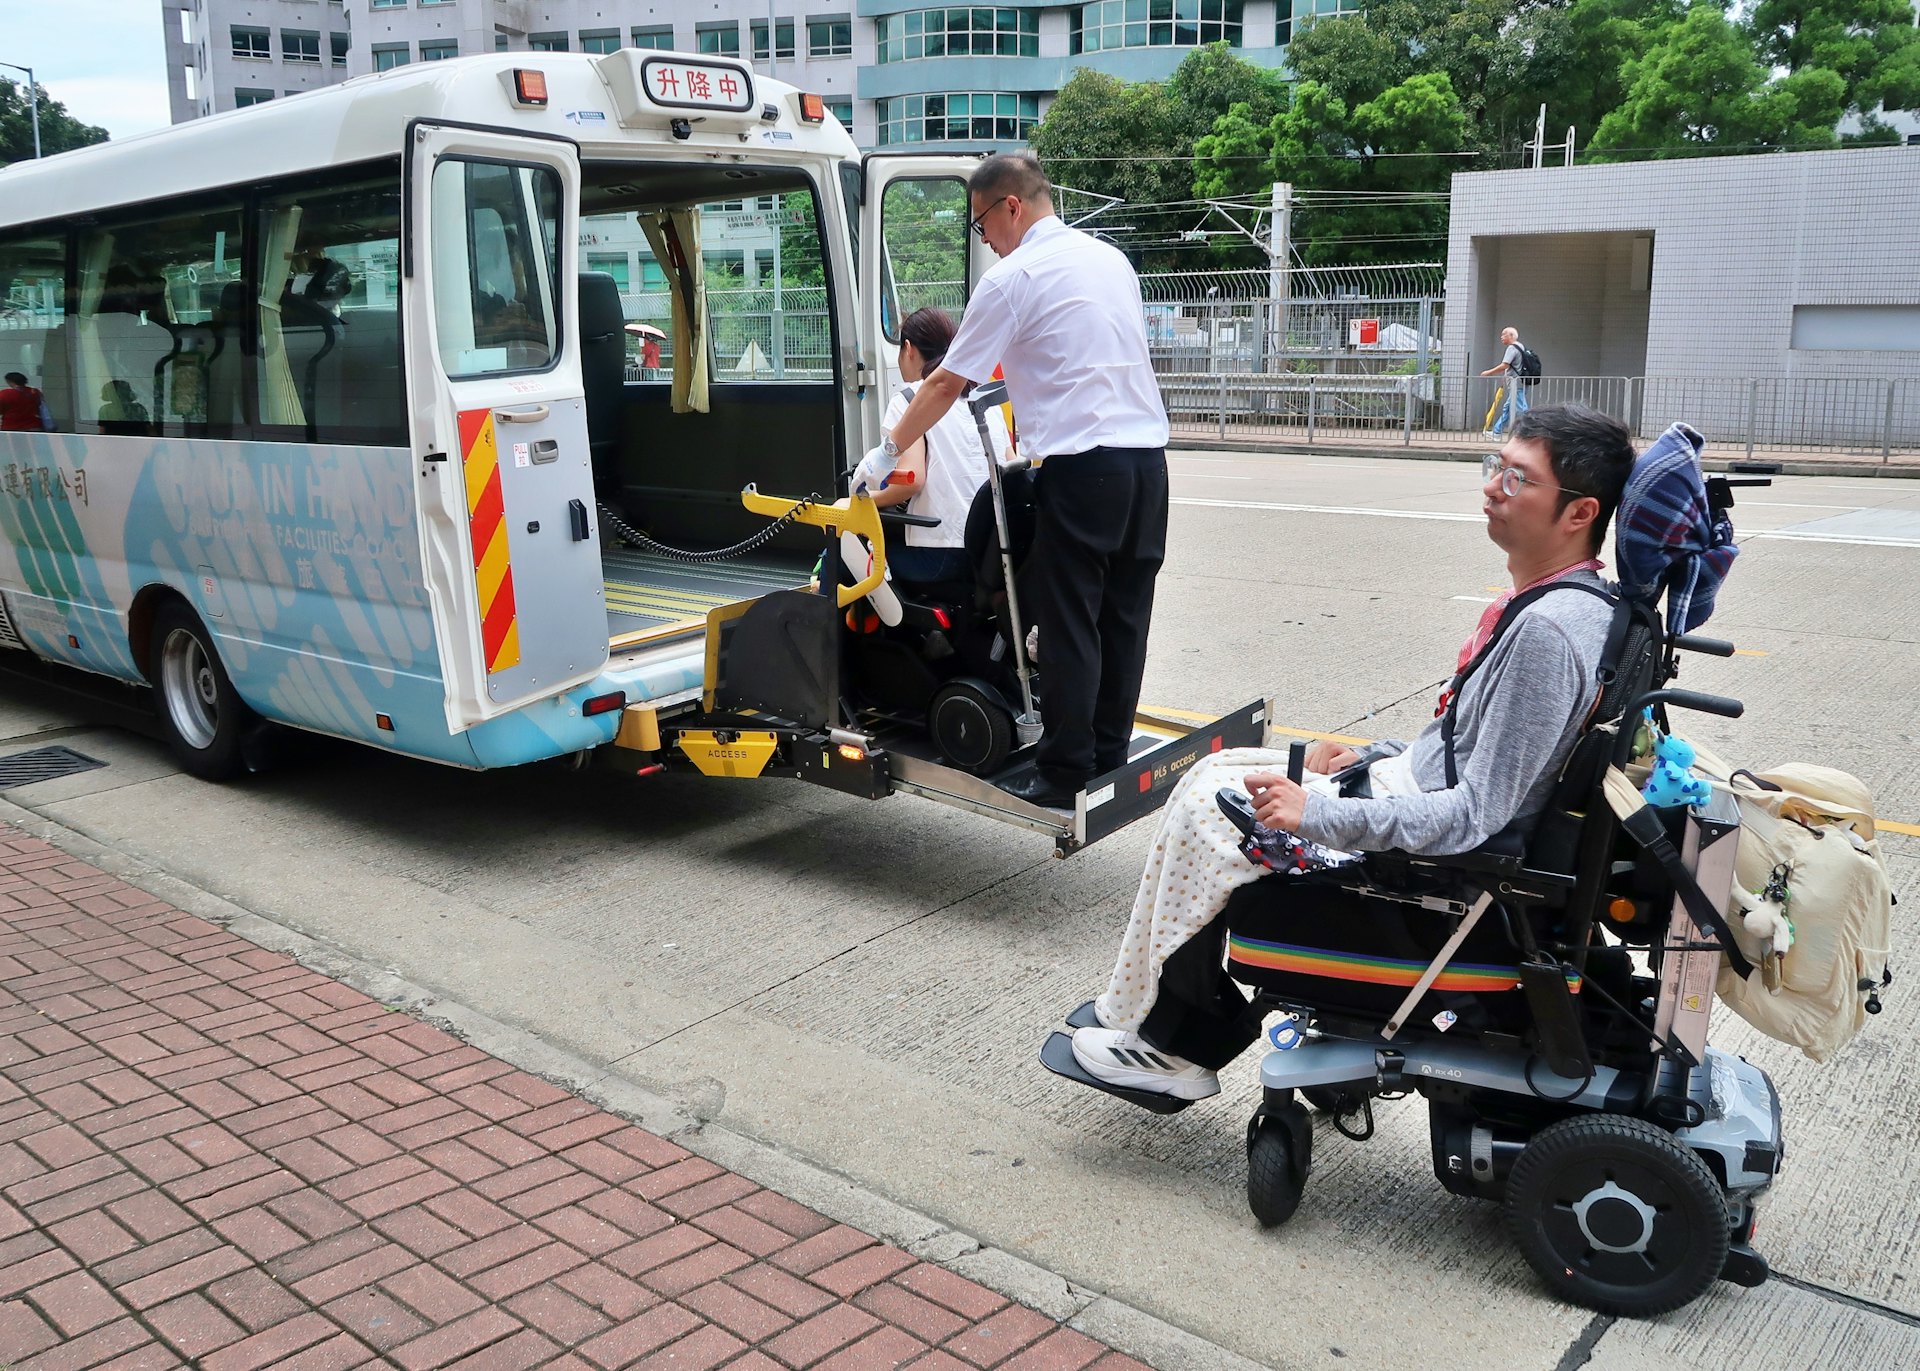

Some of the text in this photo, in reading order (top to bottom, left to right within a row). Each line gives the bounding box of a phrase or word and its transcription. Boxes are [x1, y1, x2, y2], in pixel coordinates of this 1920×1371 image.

[656, 67, 739, 102] 升降中
[514, 443, 528, 455] PULL
[0, 463, 89, 507] 運有限公司
[262, 463, 296, 516] IN
[276, 525, 350, 555] FACILITIES
[707, 749, 748, 759] ACCESS
[1153, 765, 1168, 781] PLS
[1170, 752, 1197, 772] access
